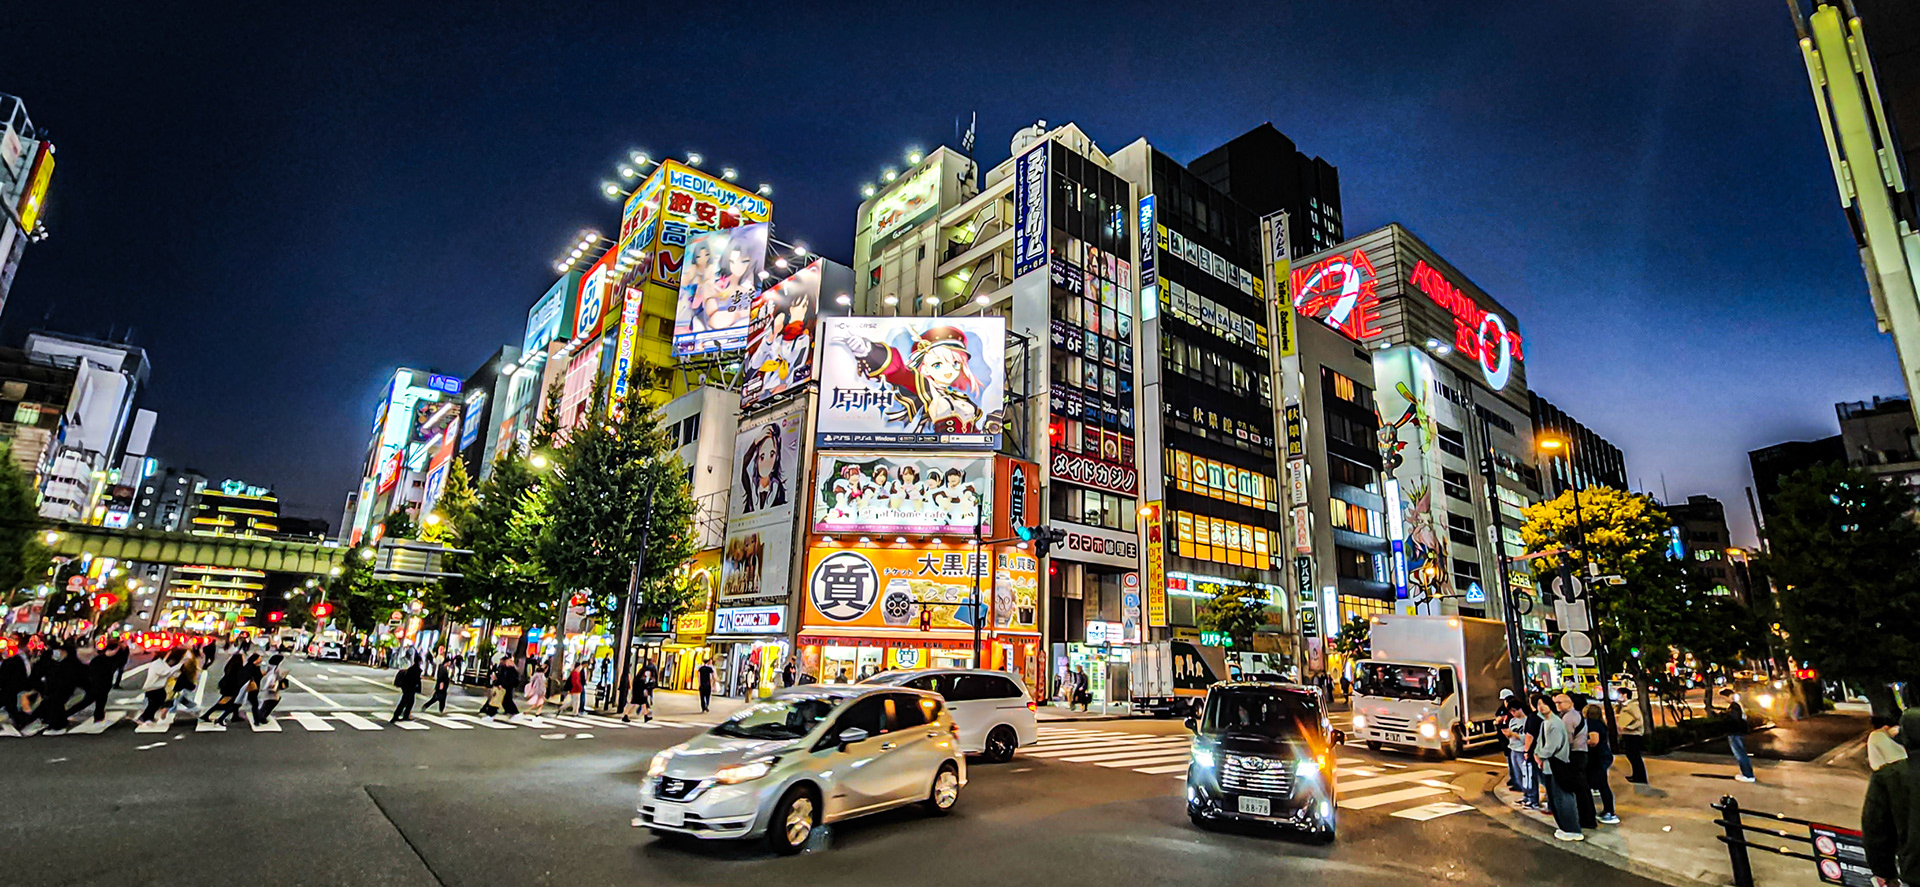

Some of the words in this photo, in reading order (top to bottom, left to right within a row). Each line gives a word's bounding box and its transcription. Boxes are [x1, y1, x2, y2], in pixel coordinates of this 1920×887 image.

[669, 170, 768, 217] MEDIAリサイクル
[1067, 277, 1082, 294] 7F
[1201, 306, 1215, 319] ON
[1217, 313, 1240, 330] SALE
[1067, 336, 1082, 353] 6F
[829, 375, 898, 419] 原神
[1067, 400, 1082, 417] 5F
[1053, 454, 1135, 491] メイドカジノ
[1069, 533, 1137, 559] スマホ修理王
[883, 567, 914, 576] チケット
[918, 552, 988, 577] 大黒屋
[820, 563, 869, 613] 質
[735, 613, 757, 626] COMIC
[758, 613, 770, 626] ZIN
[1245, 804, 1269, 814] 88-78
